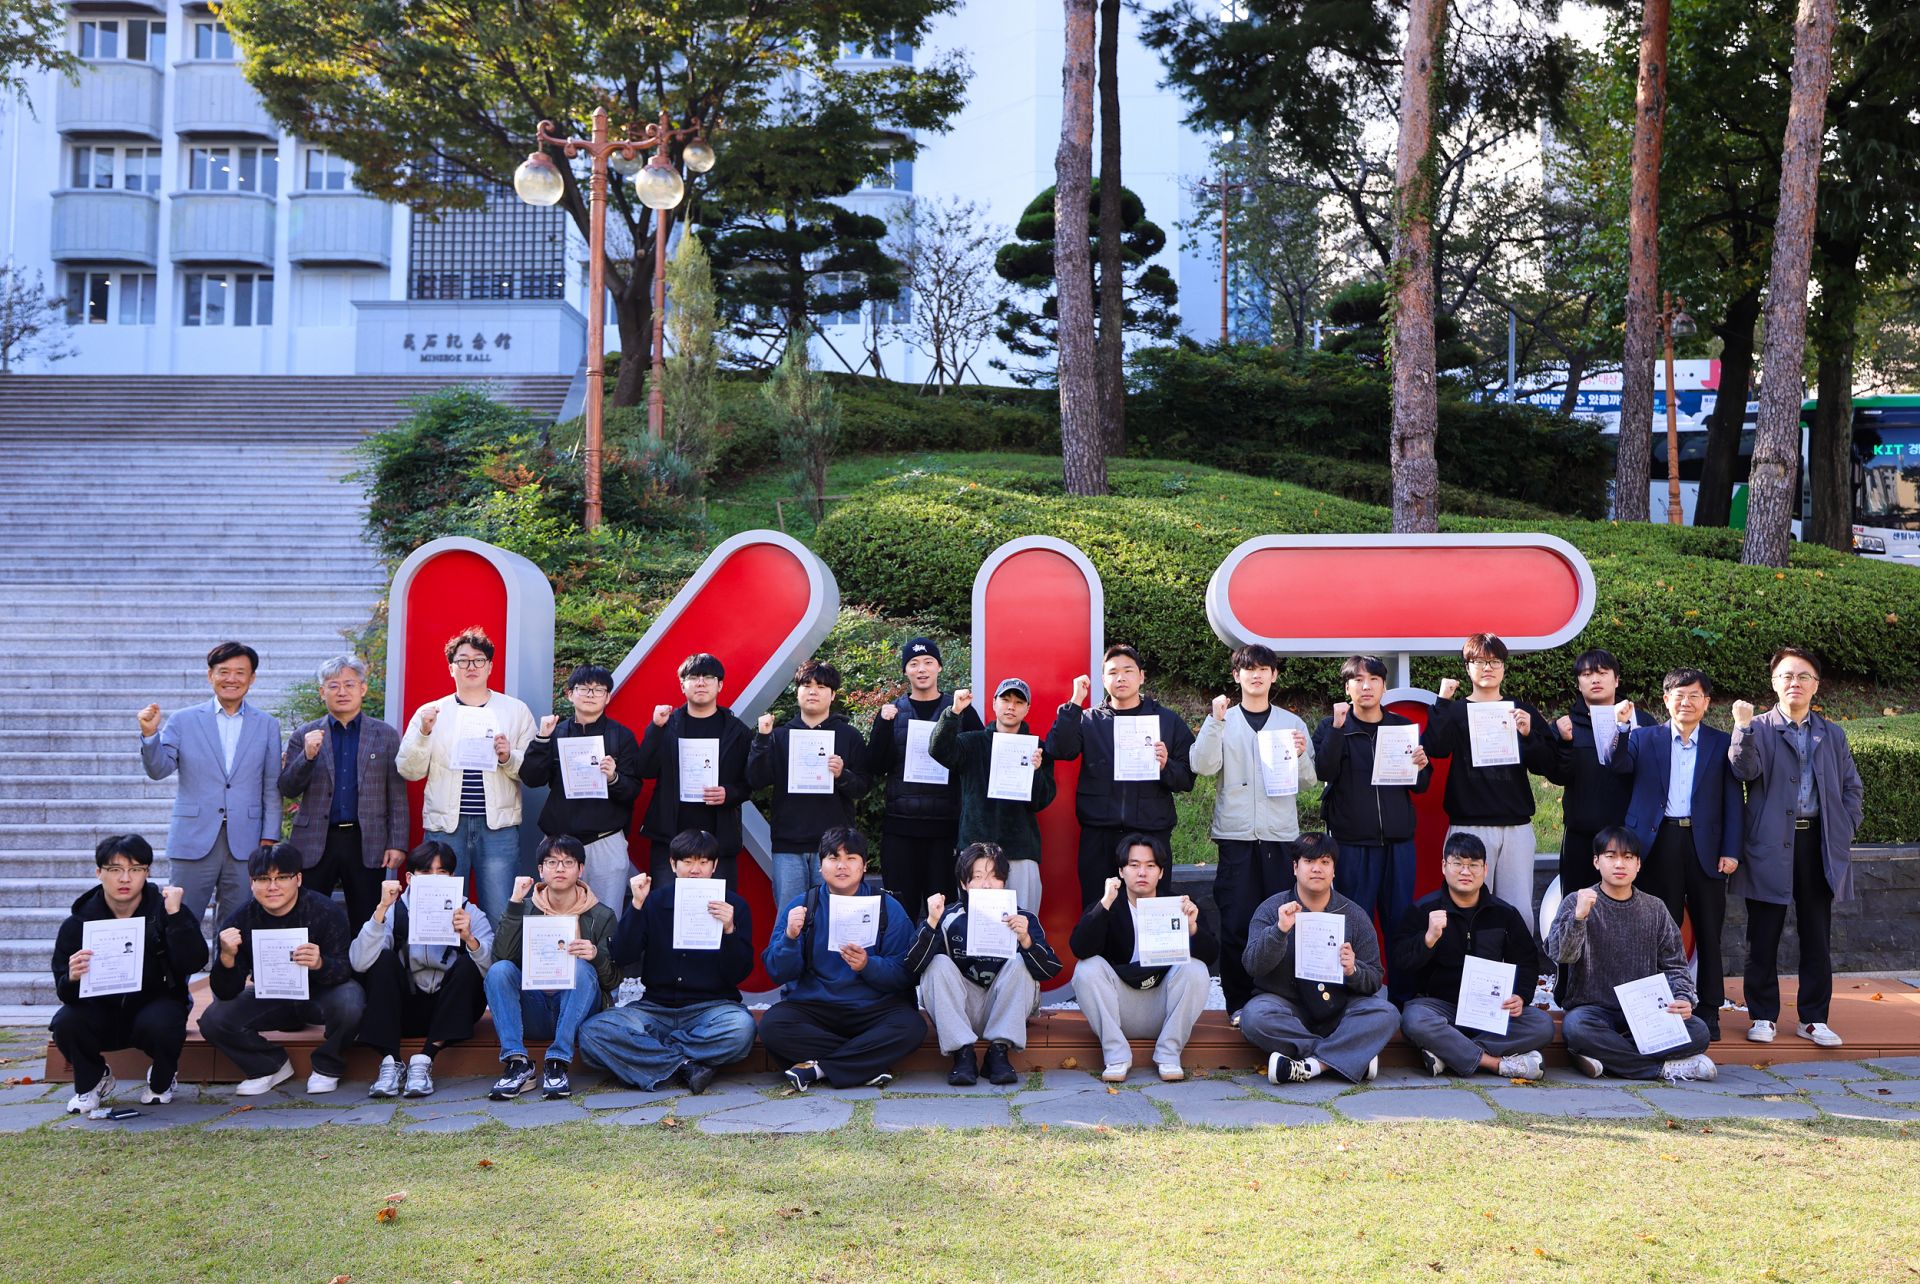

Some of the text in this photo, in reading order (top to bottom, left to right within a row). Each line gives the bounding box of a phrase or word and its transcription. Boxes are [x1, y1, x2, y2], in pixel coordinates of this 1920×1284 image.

[420, 354, 492, 362] MINSEOK HALL
[1529, 393, 1565, 405] 살아남
[1576, 393, 1586, 406] 수
[1873, 443, 1920, 456] KIT 경
